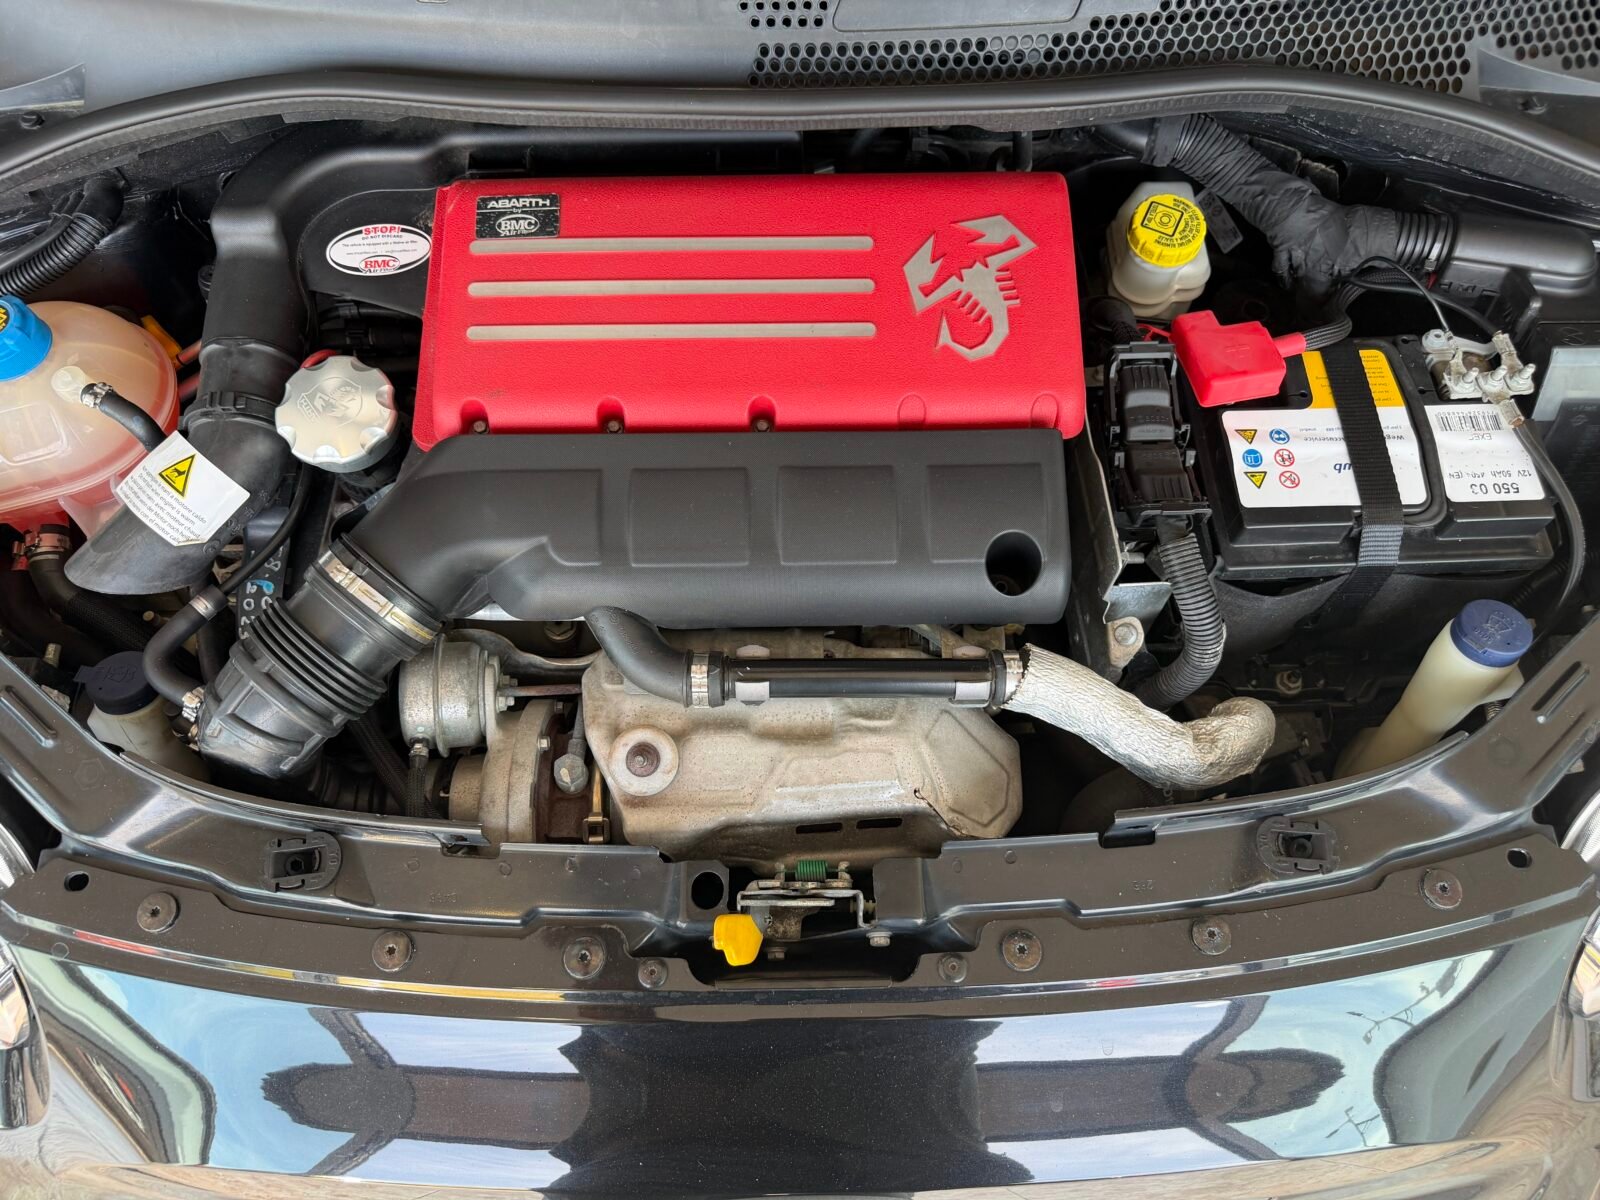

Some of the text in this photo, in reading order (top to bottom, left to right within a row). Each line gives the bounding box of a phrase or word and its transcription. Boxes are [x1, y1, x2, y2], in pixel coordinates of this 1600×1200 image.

[487, 198, 550, 208] ABARTH
[364, 226, 401, 235] STOP!
[501, 220, 535, 230] BMC
[364, 259, 398, 268] BMC
[1470, 482, 1520, 495] 550 03
[154, 502, 165, 512] avec
[165, 511, 185, 527] moteur
[160, 496, 176, 510] engine
[180, 512, 196, 526] warm
[173, 497, 193, 513] motore
[192, 511, 206, 524] caldo
[140, 510, 149, 518] con
[154, 522, 170, 535] motor
[154, 511, 167, 524] Motor
[167, 522, 180, 534] noch
